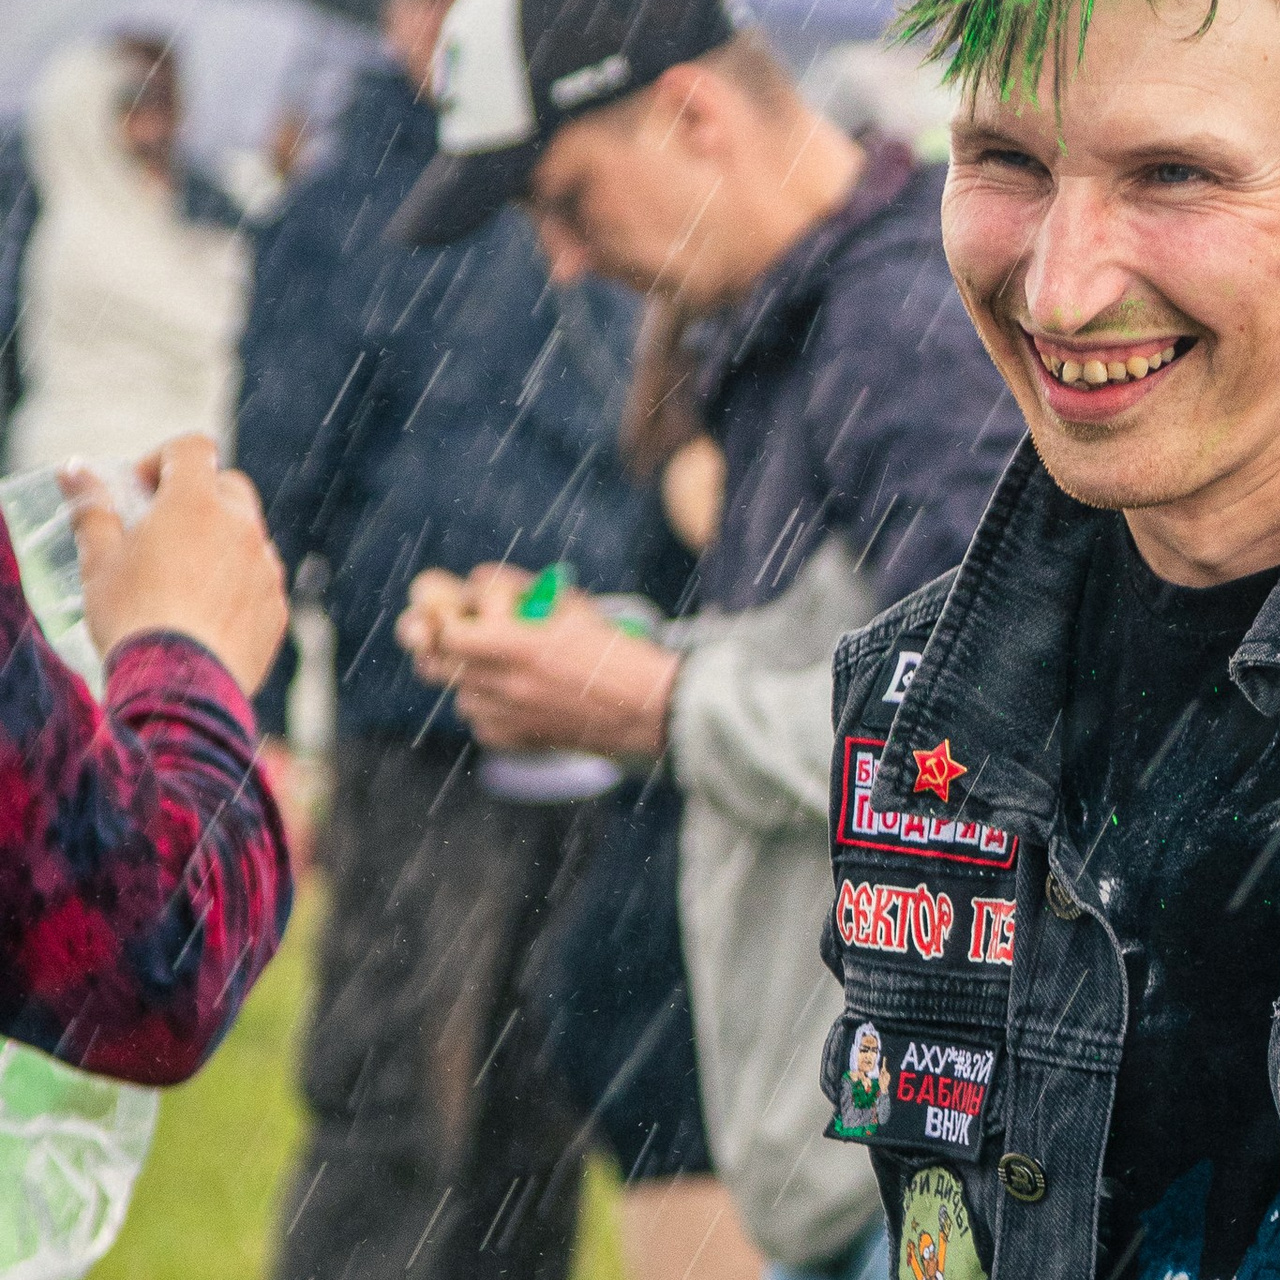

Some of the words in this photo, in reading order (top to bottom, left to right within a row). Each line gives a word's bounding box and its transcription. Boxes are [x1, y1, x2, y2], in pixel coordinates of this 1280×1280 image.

[836, 878, 954, 961] СЕКТОР
[968, 896, 1017, 966] ГАЗ
[896, 1070, 985, 1116] БАБКИН
[924, 1105, 973, 1147] ВНУК
